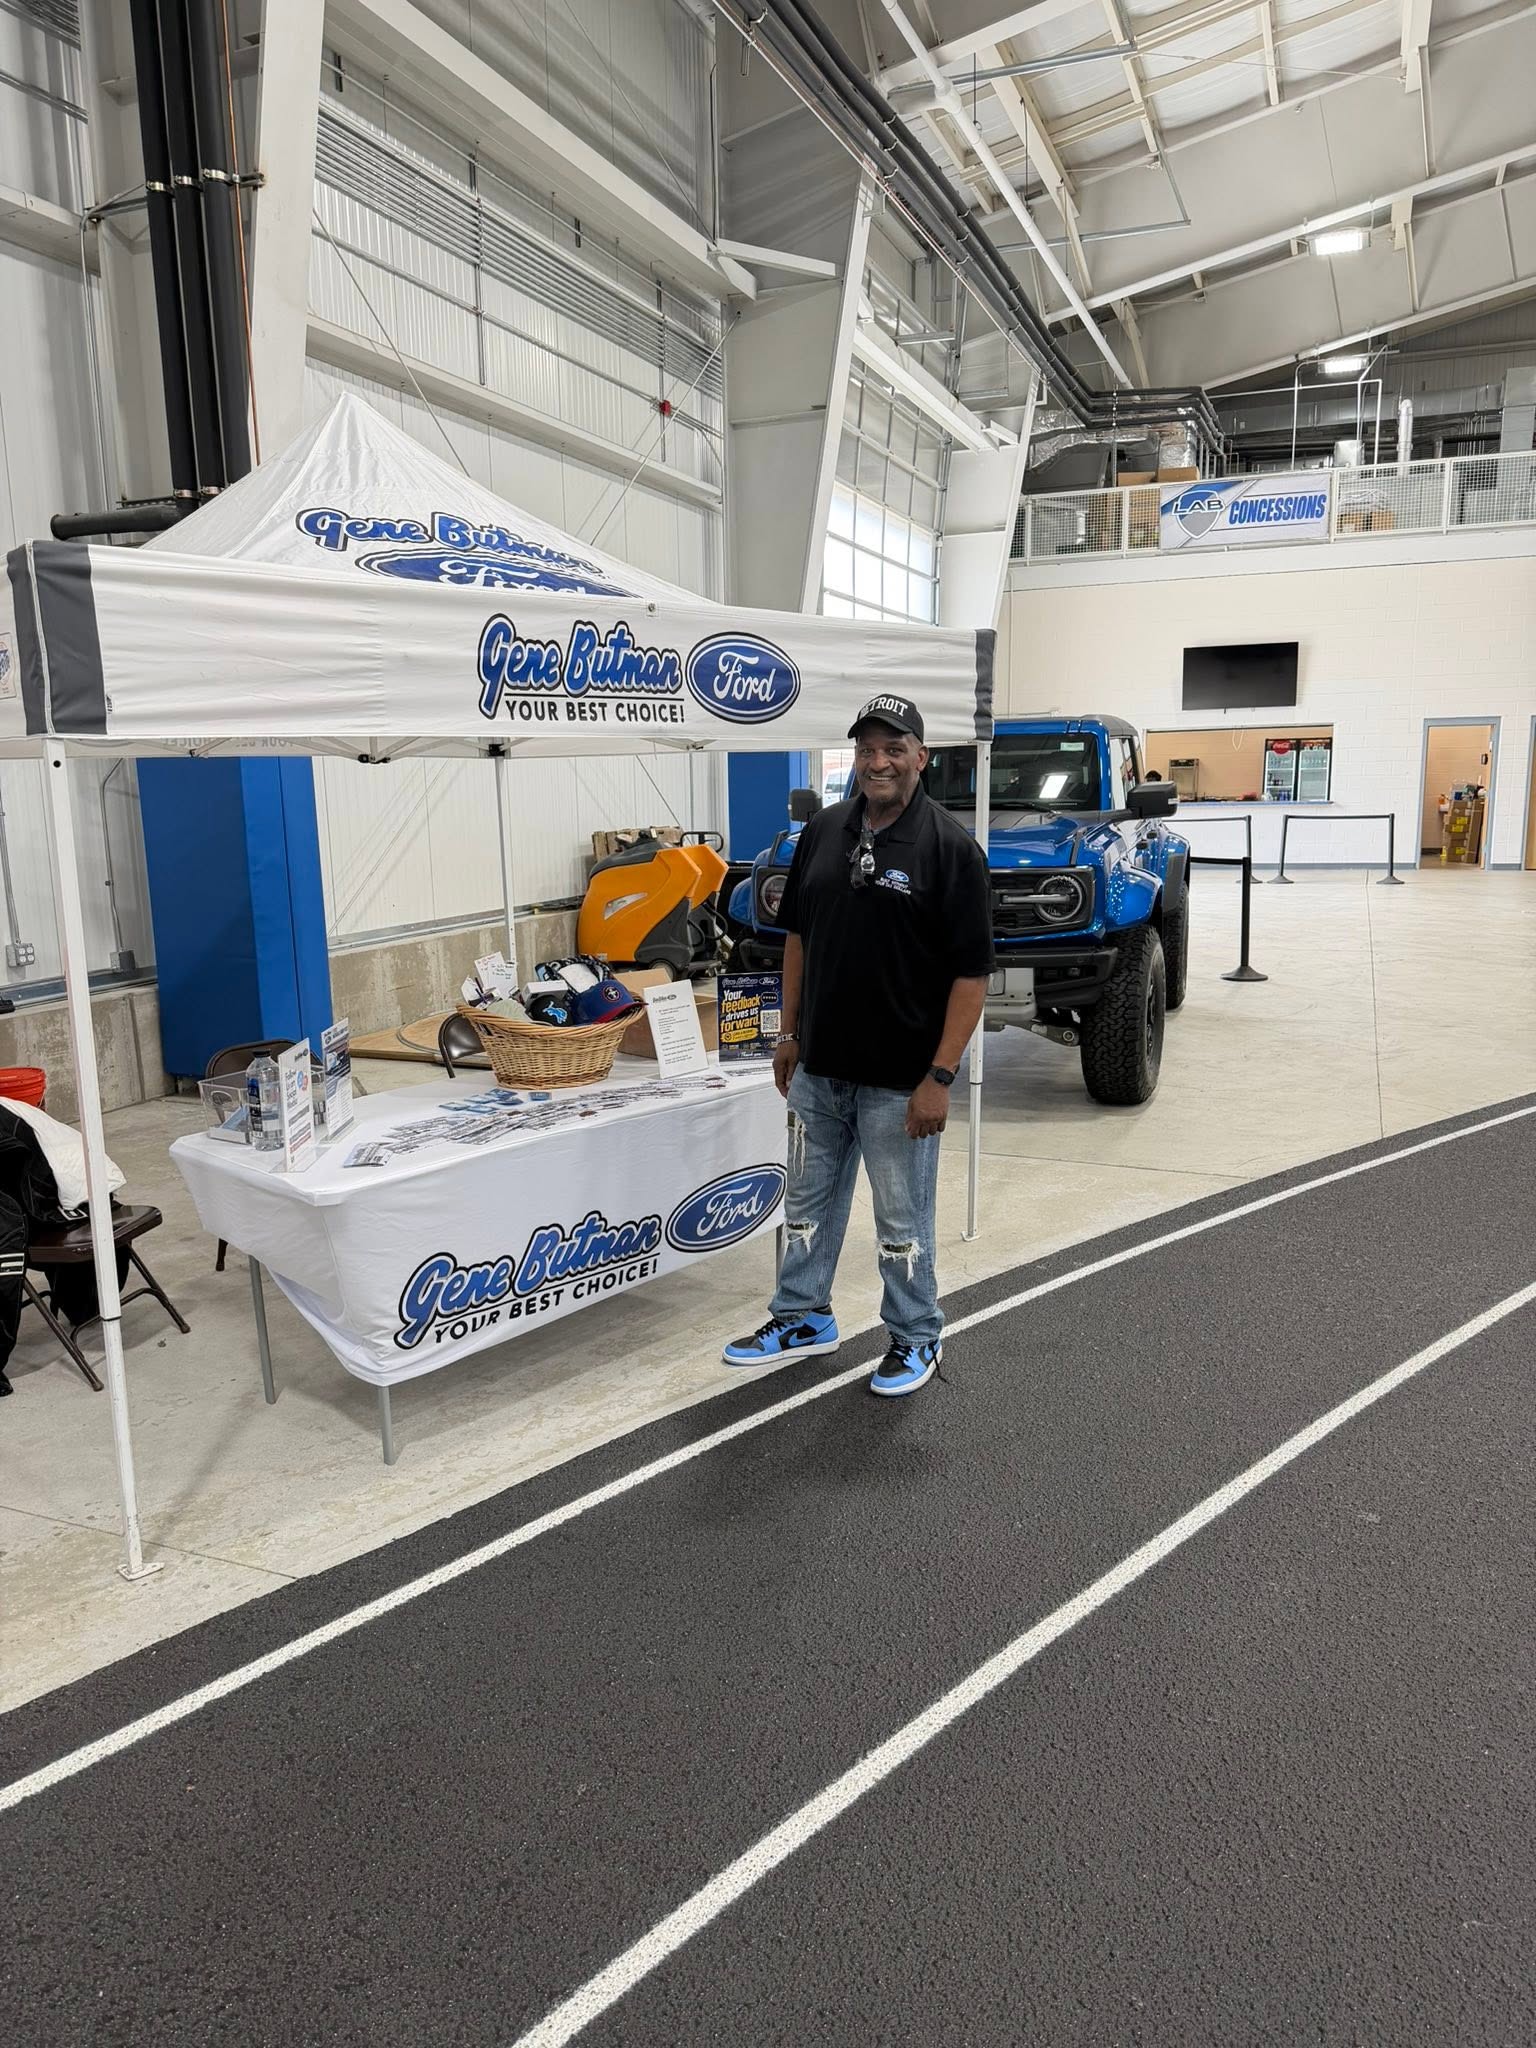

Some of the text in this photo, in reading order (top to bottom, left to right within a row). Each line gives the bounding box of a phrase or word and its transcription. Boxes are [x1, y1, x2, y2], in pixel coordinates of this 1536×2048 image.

[1172, 499, 1225, 515] LAB
[1229, 494, 1327, 525] CONCESSIONS
[296, 507, 433, 551] Gene
[477, 613, 683, 720] Gene Butman
[713, 651, 776, 702] Ford
[505, 700, 685, 723] YOUR BEST CHOICE!
[721, 994, 760, 1013] feedback
[723, 989, 743, 1001] Your
[720, 1014, 761, 1033] forward.
[725, 1007, 759, 1021] drives us
[696, 1182, 764, 1236] Ford
[394, 1210, 662, 1349] Gene Butman
[433, 1258, 659, 1344] YOUR BEST CHOICE!
